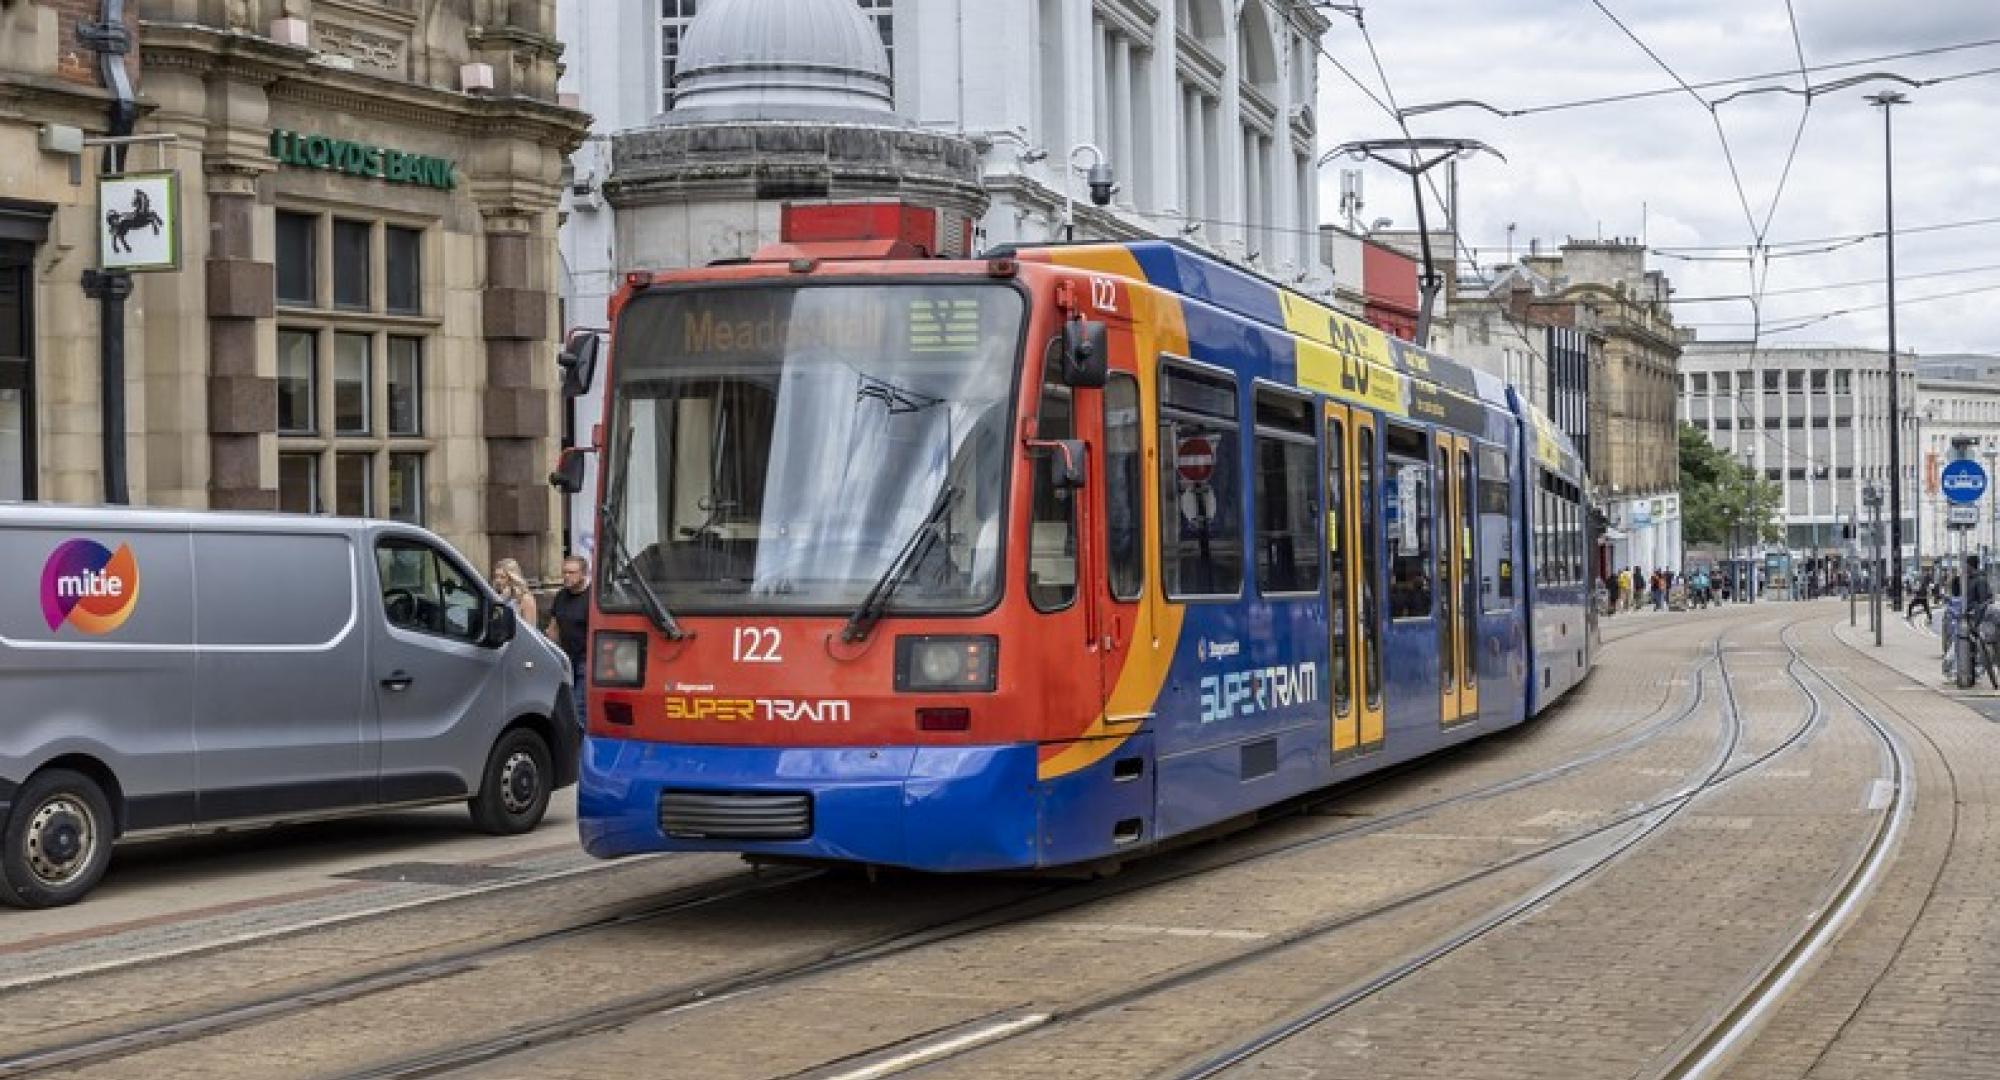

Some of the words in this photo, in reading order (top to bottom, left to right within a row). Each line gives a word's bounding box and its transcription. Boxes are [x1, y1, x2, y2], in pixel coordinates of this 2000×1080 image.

[270, 128, 379, 177] LLOYDS
[384, 149, 457, 191] BANK
[1090, 275, 1117, 312] 122
[57, 568, 122, 596] mitie
[732, 626, 783, 662] 122
